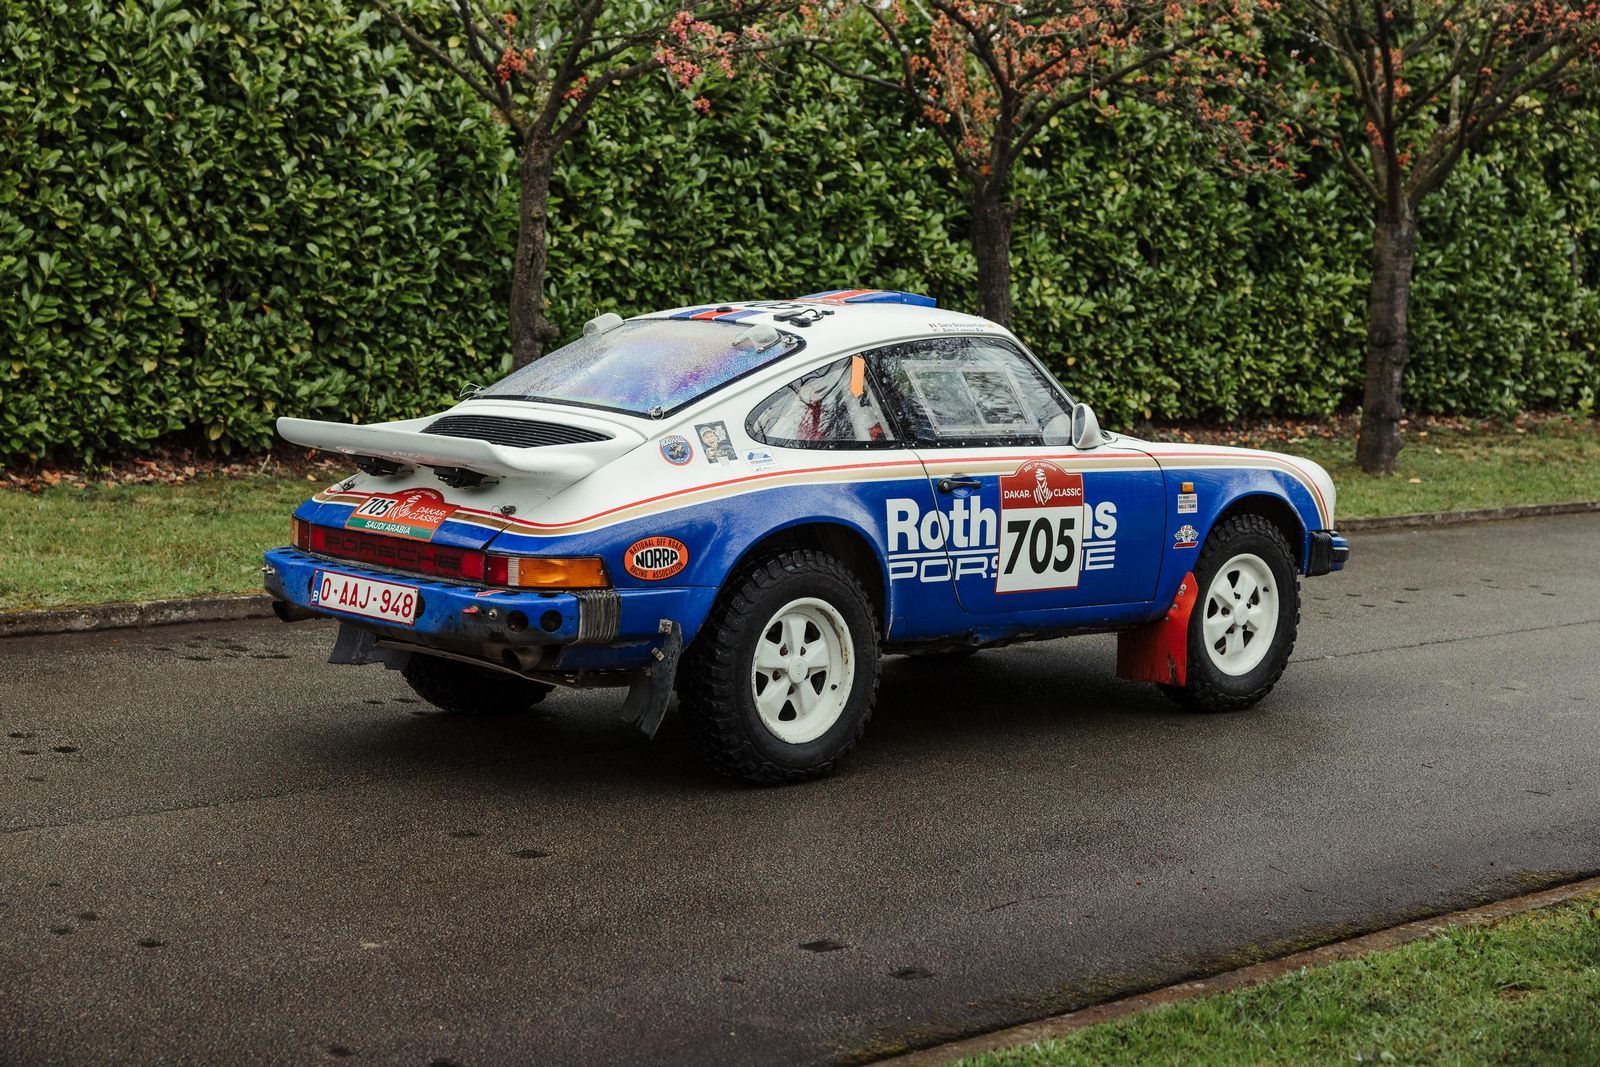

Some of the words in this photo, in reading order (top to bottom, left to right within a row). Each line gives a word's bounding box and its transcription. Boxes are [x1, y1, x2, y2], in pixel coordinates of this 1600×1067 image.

[1004, 489, 1030, 499] DAKAR
[1053, 488, 1082, 498] CLASSIC
[358, 497, 397, 516] 705
[416, 506, 447, 517] DAKAR
[408, 512, 442, 524] CLASSIC
[365, 520, 387, 532] SAUDI
[384, 523, 411, 535] ARABIA
[628, 539, 655, 556] NATIONAL
[656, 537, 666, 547] OFF
[668, 539, 683, 552] ROAD
[1003, 517, 1075, 575] 705
[635, 547, 679, 569] NORRA
[629, 564, 648, 579] RACING
[652, 560, 684, 579] ASSOCIATION
[312, 590, 320, 602] B
